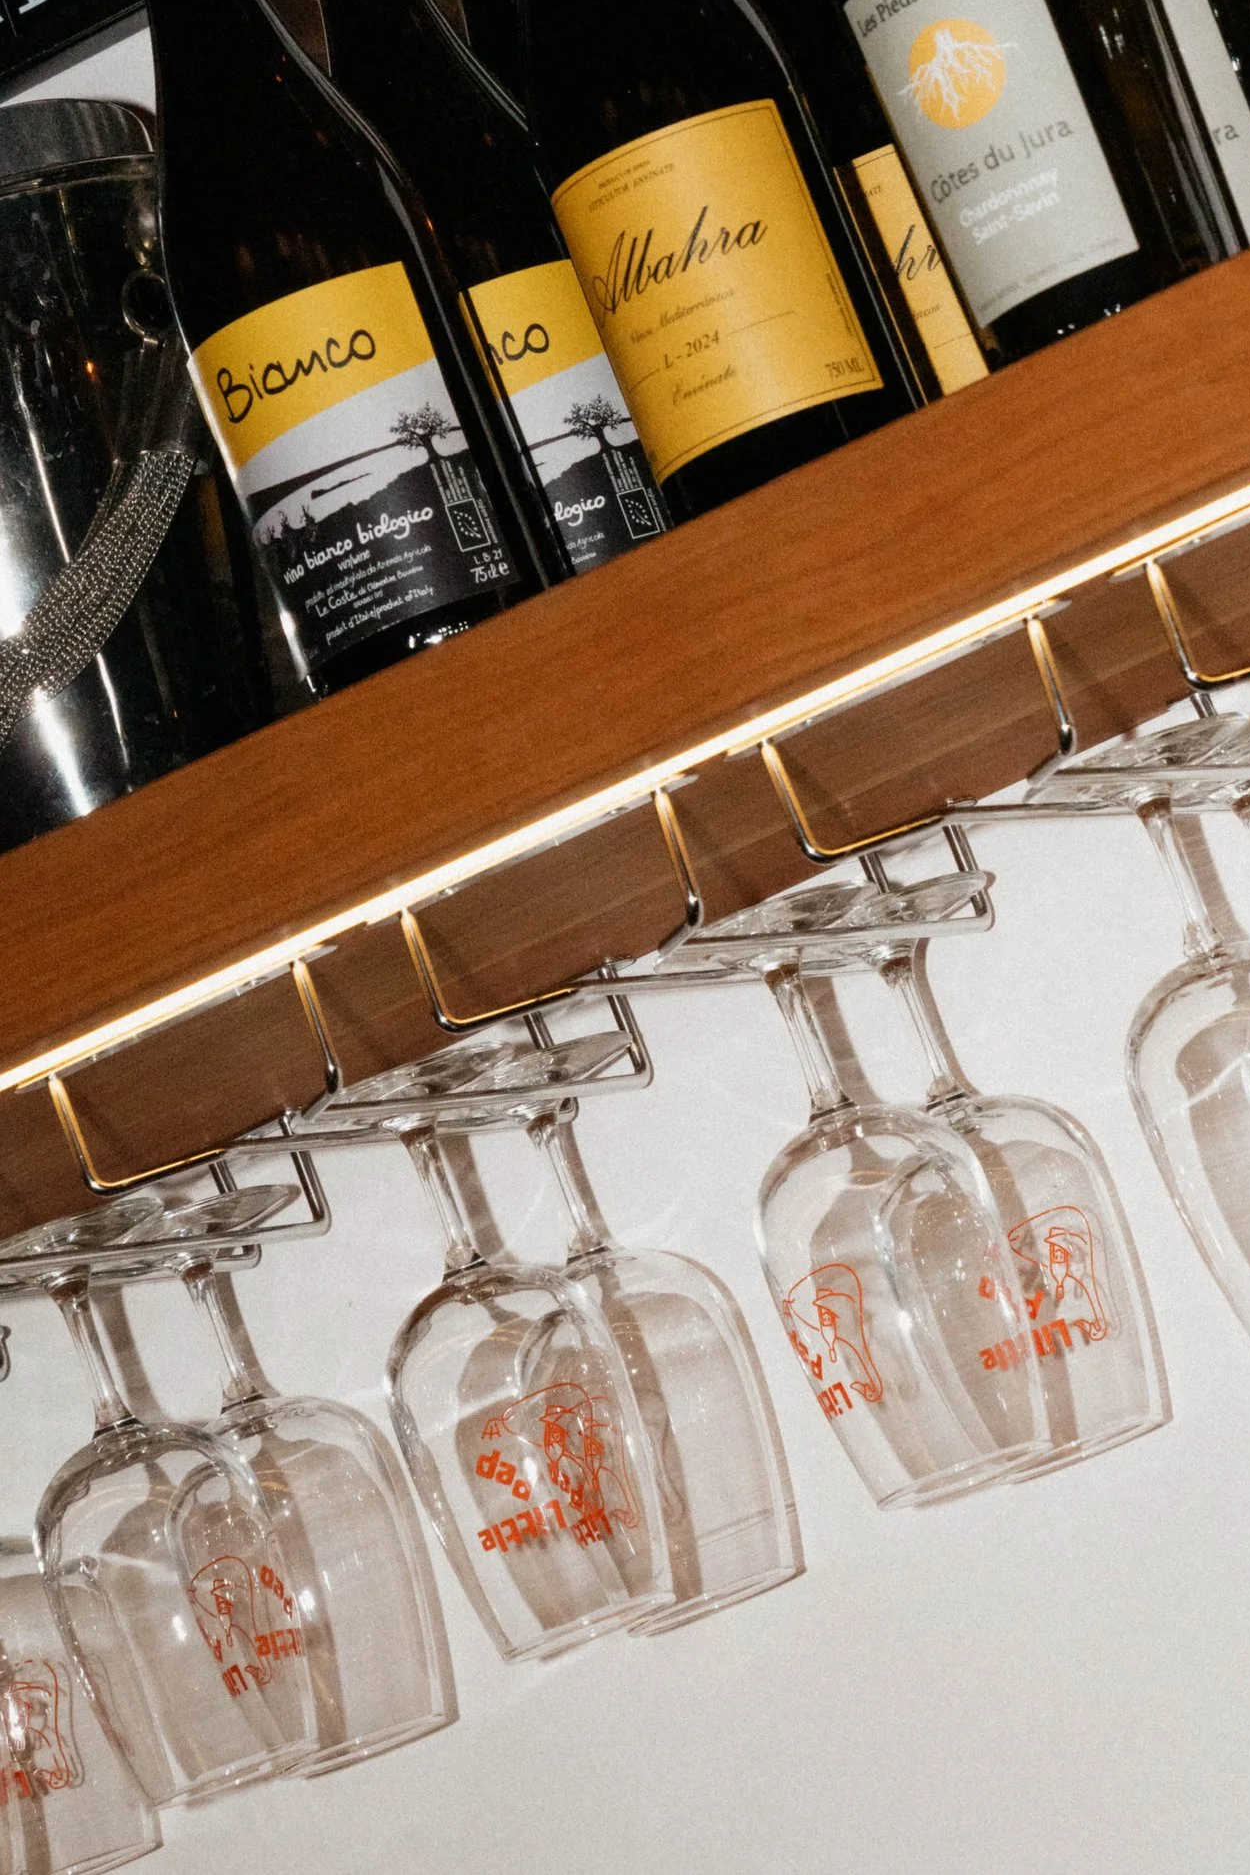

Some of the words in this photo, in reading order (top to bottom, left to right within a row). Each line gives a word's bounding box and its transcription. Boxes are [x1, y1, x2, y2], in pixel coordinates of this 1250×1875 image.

[856, 16, 877, 39] Les
[930, 160, 980, 204] Côtes
[982, 143, 1016, 171] du
[1018, 118, 1074, 158] Jura
[593, 205, 769, 329] Albahra
[216, 328, 376, 424] Bianco
[684, 328, 720, 359] 2024
[283, 564, 305, 586] vino
[303, 538, 353, 570] bianco
[356, 506, 434, 545] biologico
[315, 603, 330, 618] Le
[328, 589, 358, 610] Coste
